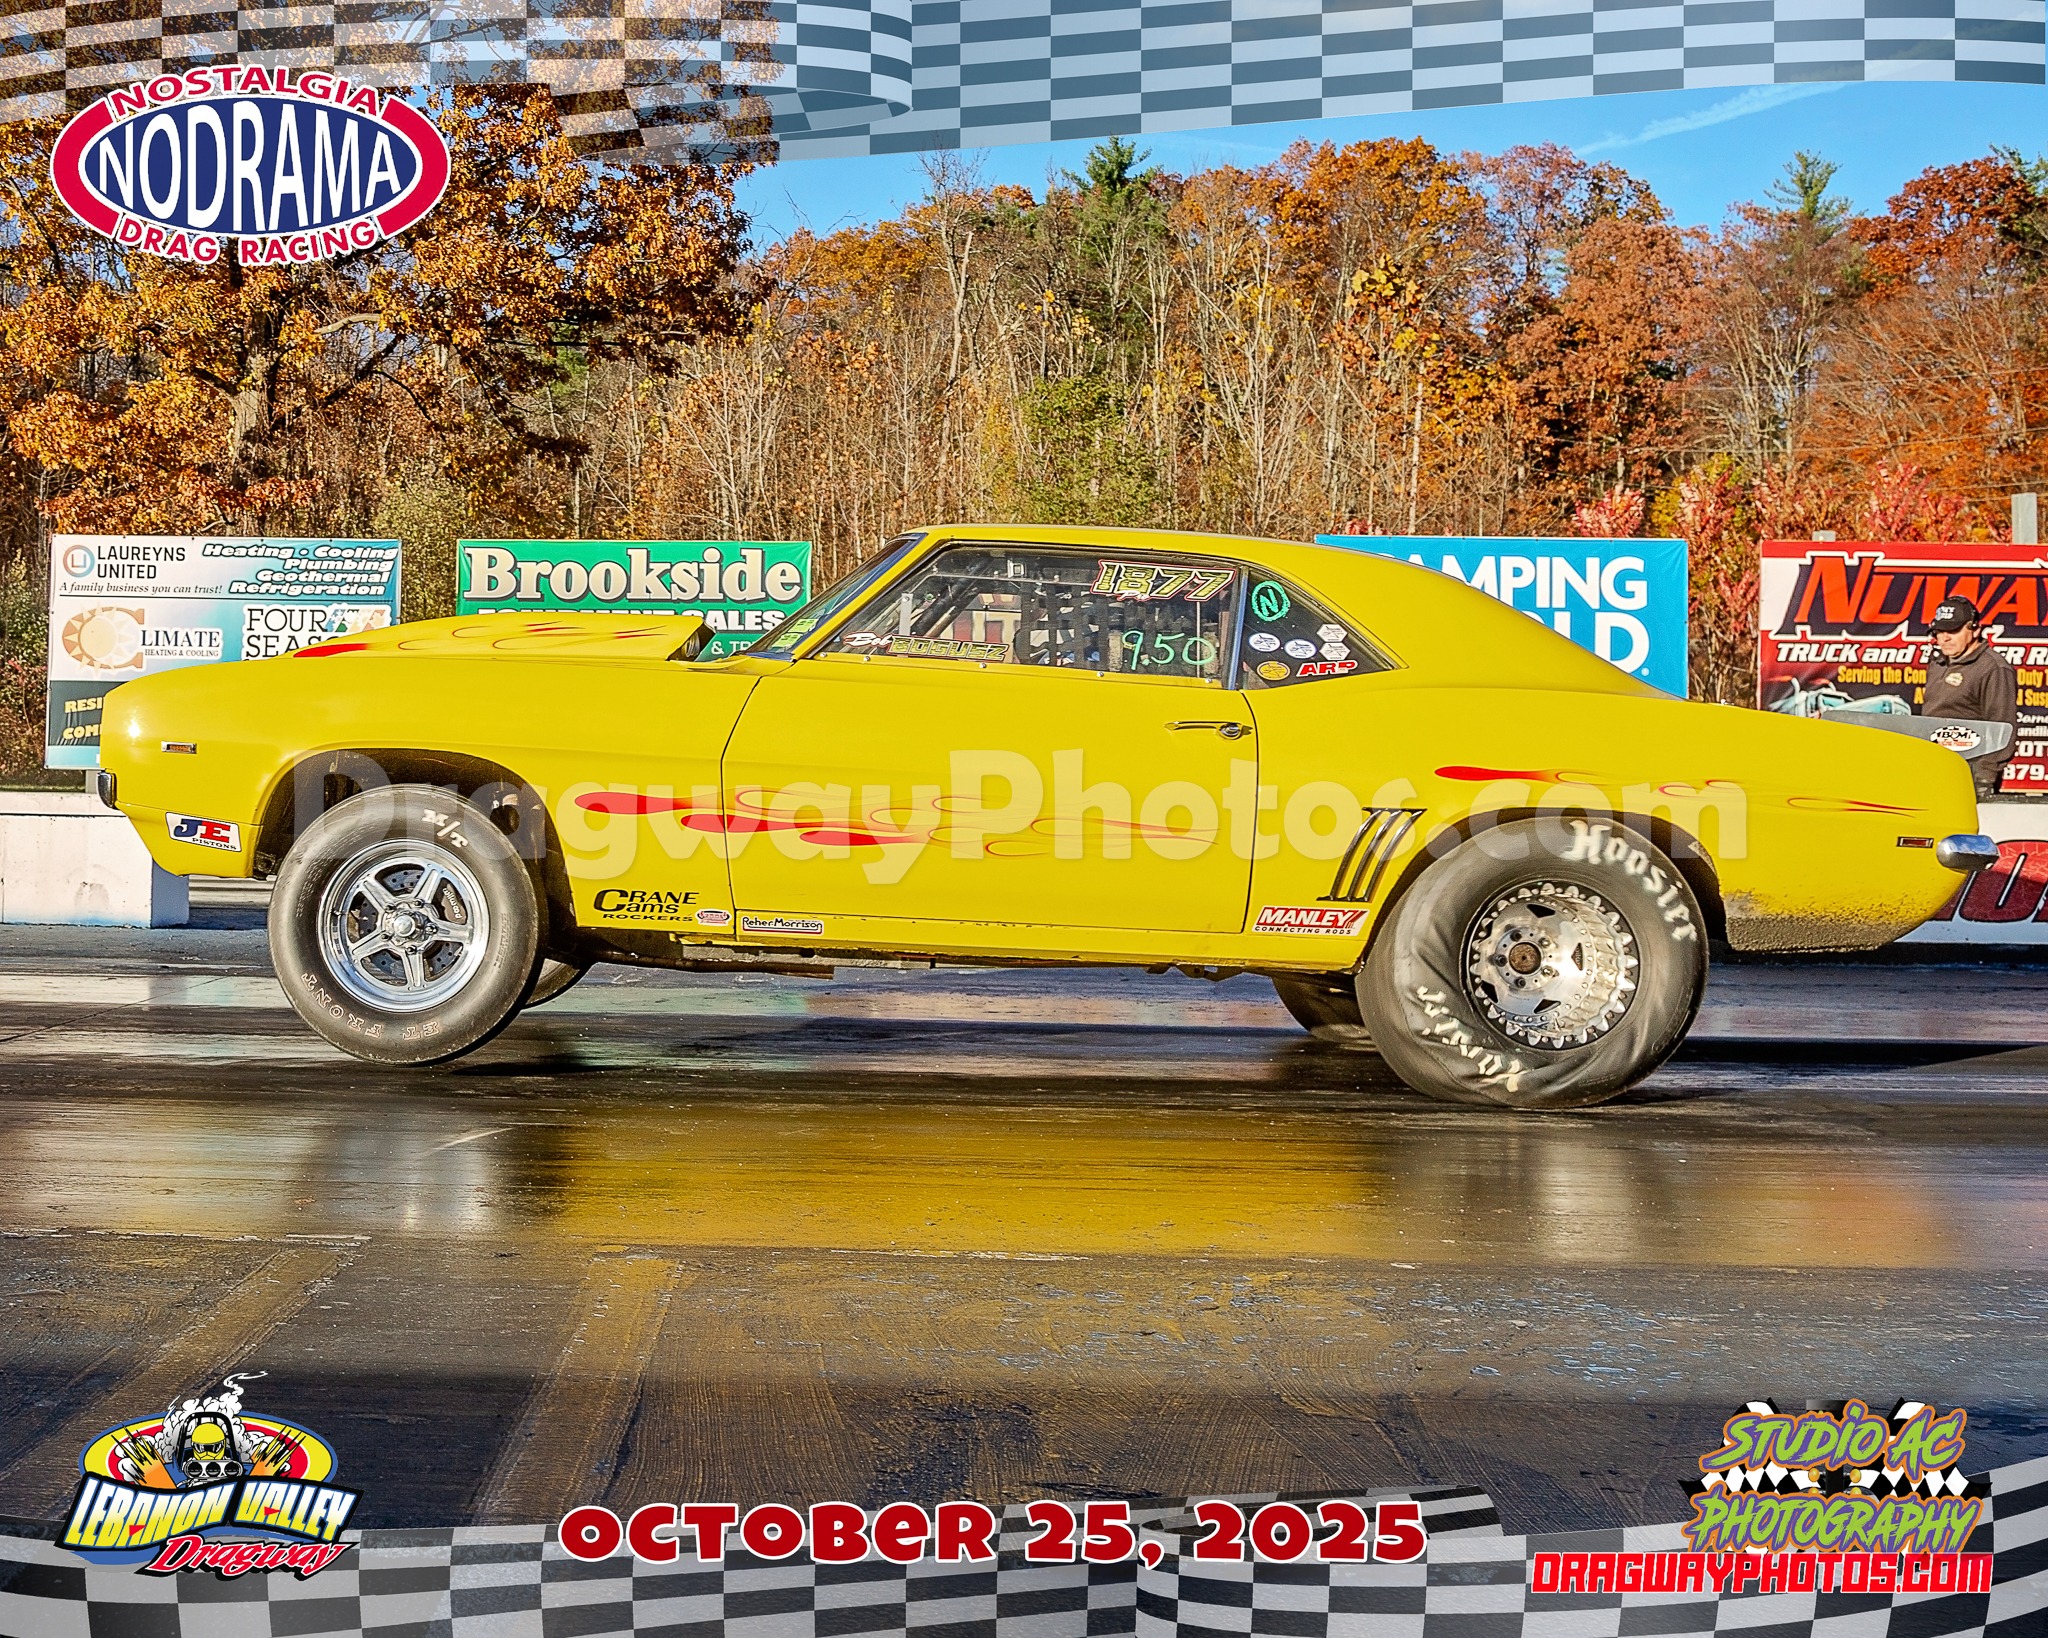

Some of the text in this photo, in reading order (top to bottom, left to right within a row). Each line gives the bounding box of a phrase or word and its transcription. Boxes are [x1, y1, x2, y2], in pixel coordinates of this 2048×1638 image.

[97, 545, 186, 562] LAUREYNS
[203, 543, 399, 560] Heating Cooling
[97, 563, 157, 579] UNITED
[283, 558, 395, 572] Plumbing
[256, 569, 392, 584] Geothermal
[463, 547, 802, 603] Brookside
[1092, 560, 1236, 601] 1877
[1378, 553, 1648, 610] MPING
[59, 582, 223, 596] A family business you can trust!
[229, 581, 386, 597] Refrigeration
[1794, 555, 2048, 626] NUWA
[246, 608, 328, 632] FOUR
[681, 609, 785, 631] ALES
[711, 641, 724, 655] &
[843, 632, 892, 648] Bob
[144, 648, 177, 657] HEATING
[185, 649, 219, 657] COOLING
[1121, 628, 1217, 671] 9.50
[1776, 642, 1861, 663] TRUCK
[1861, 644, 1916, 663] and
[1297, 660, 1358, 677] ARP
[1837, 665, 1881, 686] Serving
[1882, 666, 1902, 684] the
[2017, 668, 2044, 688] Duty
[62, 723, 102, 740] COM
[173, 818, 231, 843] JE
[422, 809, 469, 848] M/T
[191, 838, 237, 850] PISTONS
[602, 914, 693, 922] ROCKERS
[1258, 907, 1355, 927] MANLEY
[1254, 925, 1320, 934] CONNECTING
[301, 972, 441, 1041] ET FRONT
